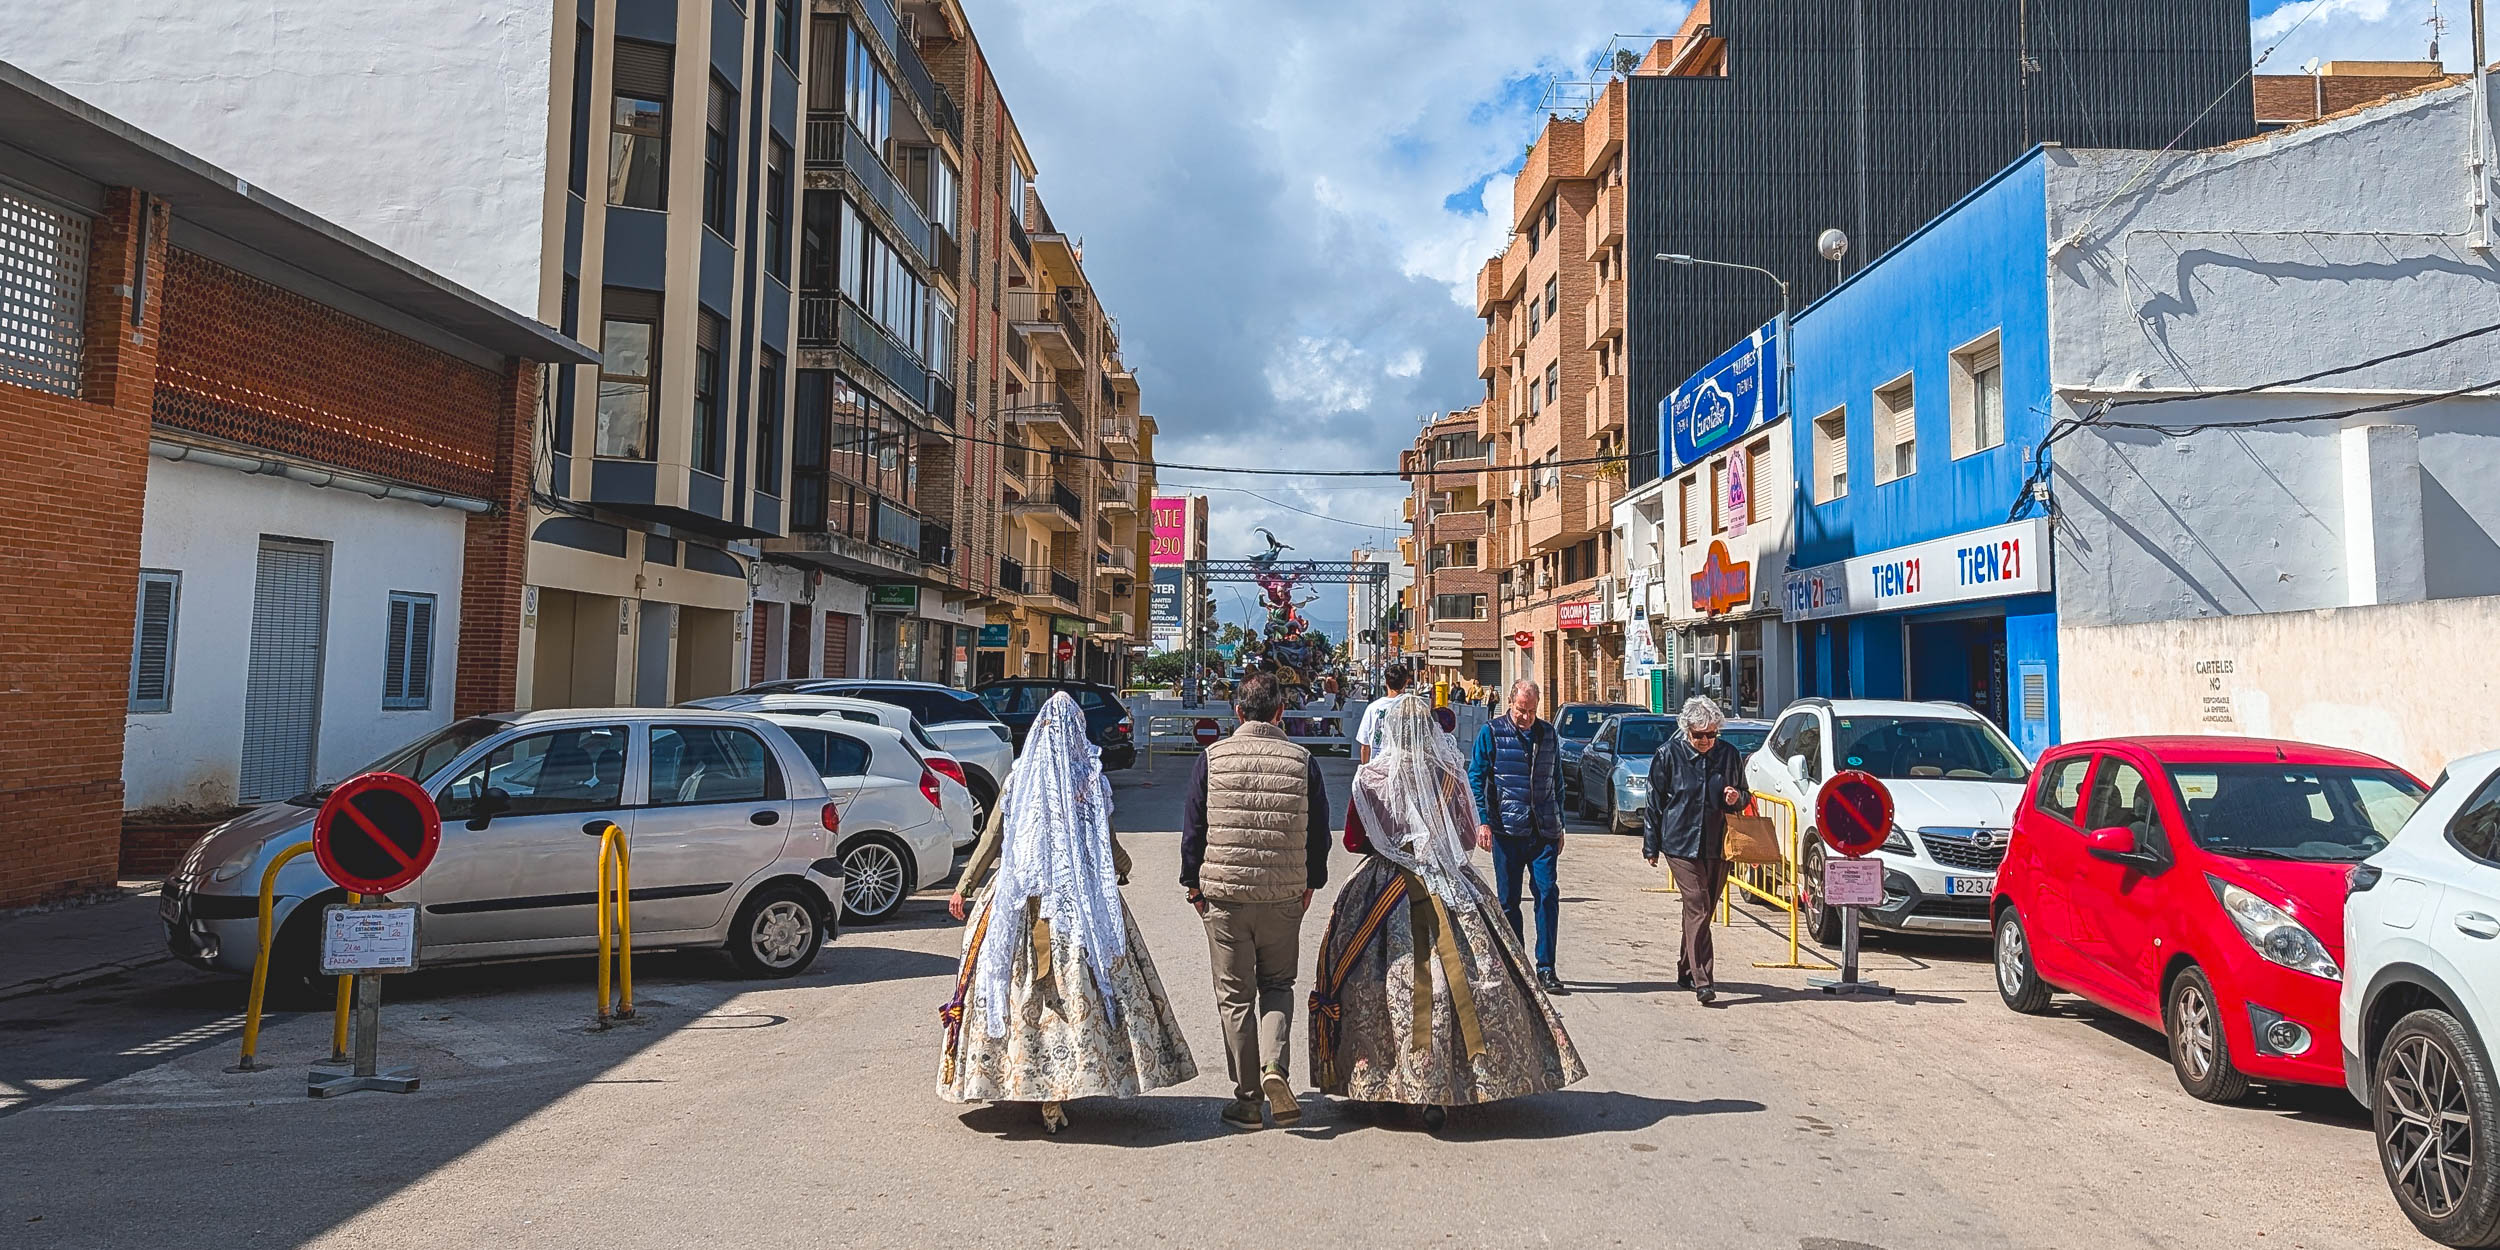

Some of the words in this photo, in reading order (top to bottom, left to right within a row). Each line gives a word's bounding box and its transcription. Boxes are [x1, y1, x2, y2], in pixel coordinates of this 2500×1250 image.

[1825, 586, 1843, 606] COSTA
[2196, 660, 2234, 674] CARTELES
[2209, 677, 2221, 690] NO
